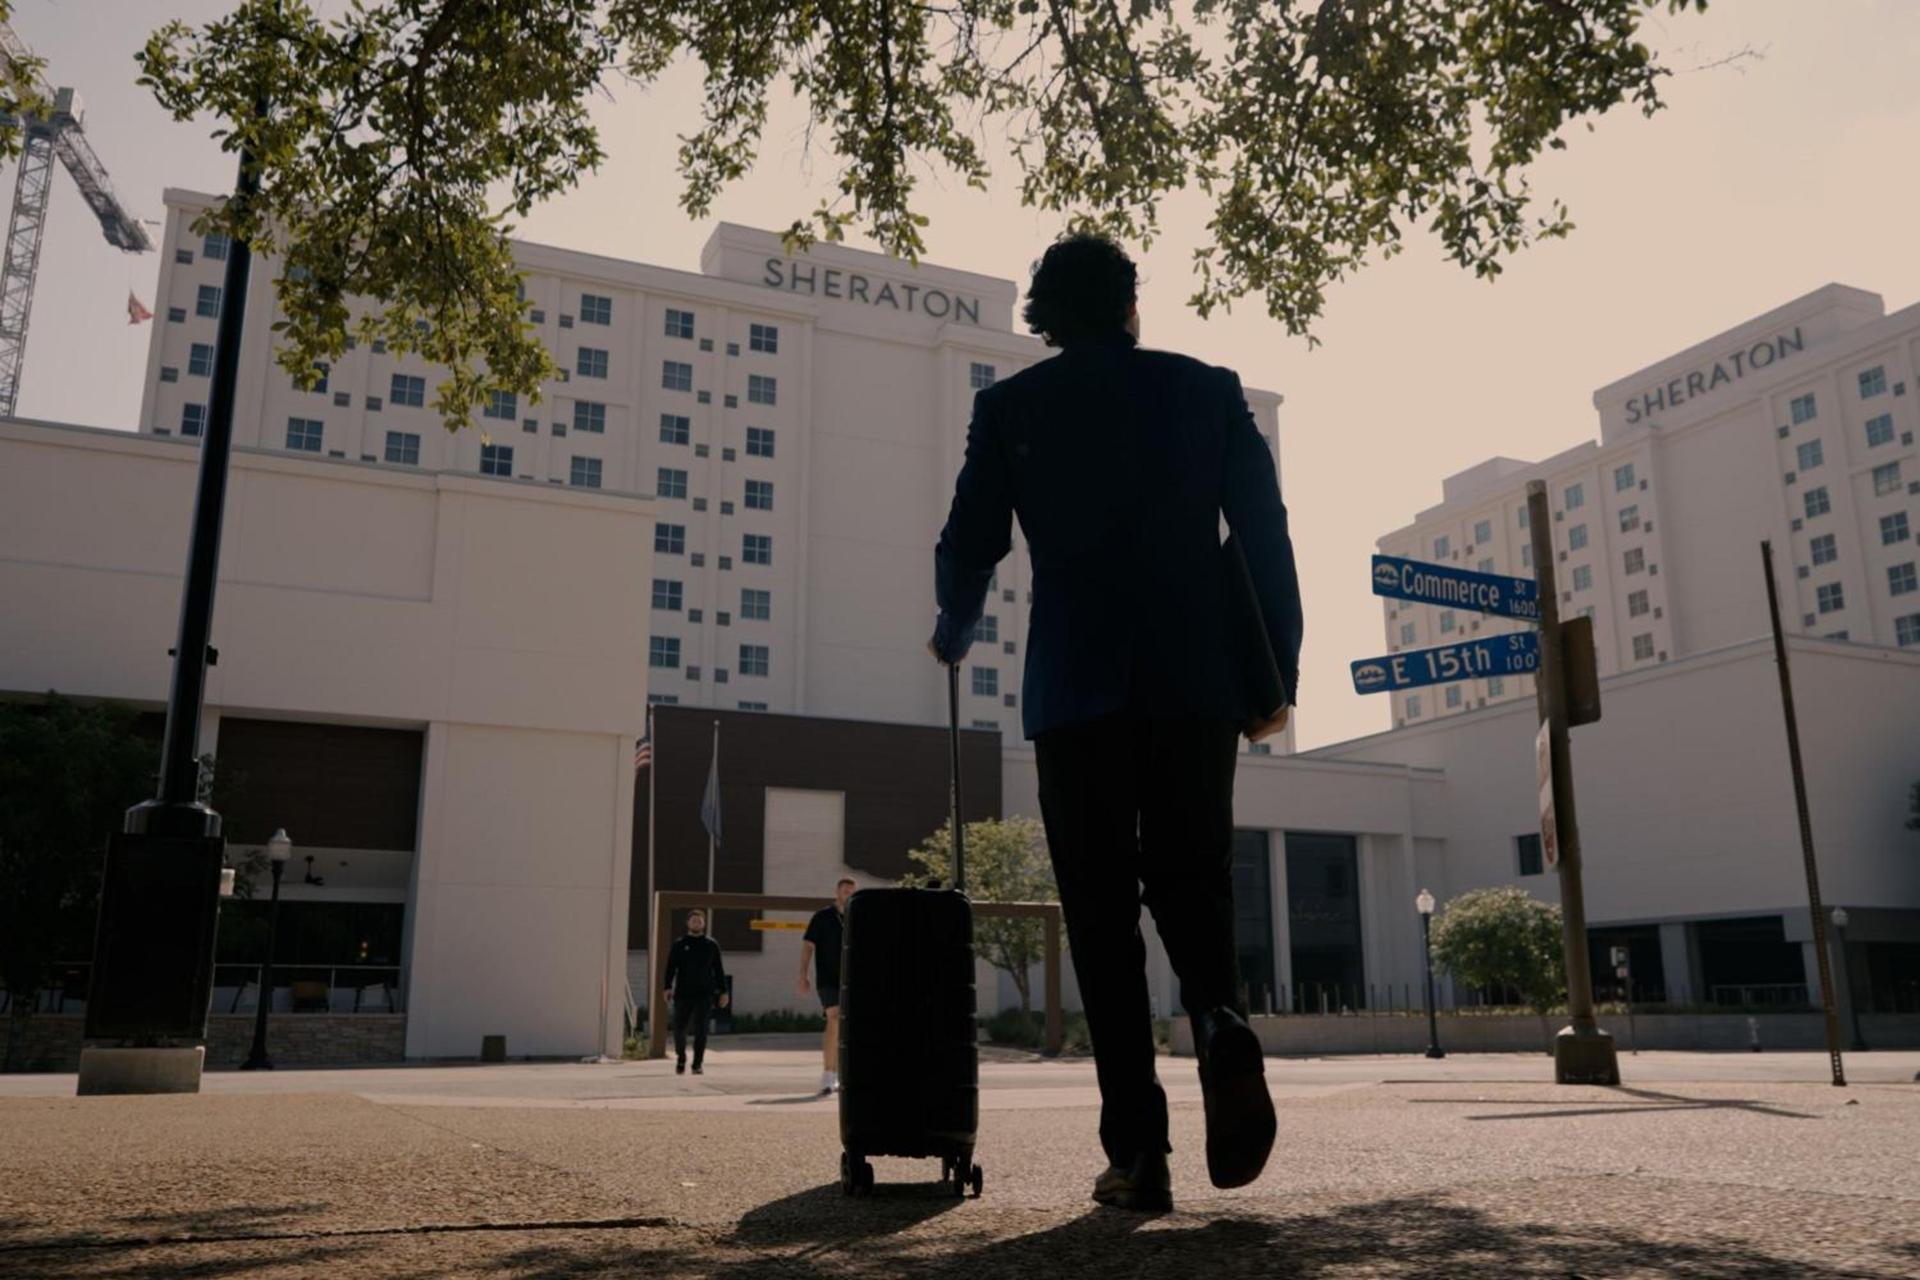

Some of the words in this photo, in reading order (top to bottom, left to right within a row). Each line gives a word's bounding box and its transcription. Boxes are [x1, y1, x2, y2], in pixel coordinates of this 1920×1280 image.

[763, 257, 980, 324] SHERATON
[1625, 326, 1804, 425] SHERATON
[1401, 563, 1500, 608] Commerce
[1513, 579, 1526, 596] St
[1508, 598, 1537, 617] 1600
[1391, 656, 1411, 685] E
[1425, 644, 1492, 680] 15th
[1508, 635, 1526, 651] St
[1505, 654, 1536, 671] 100
